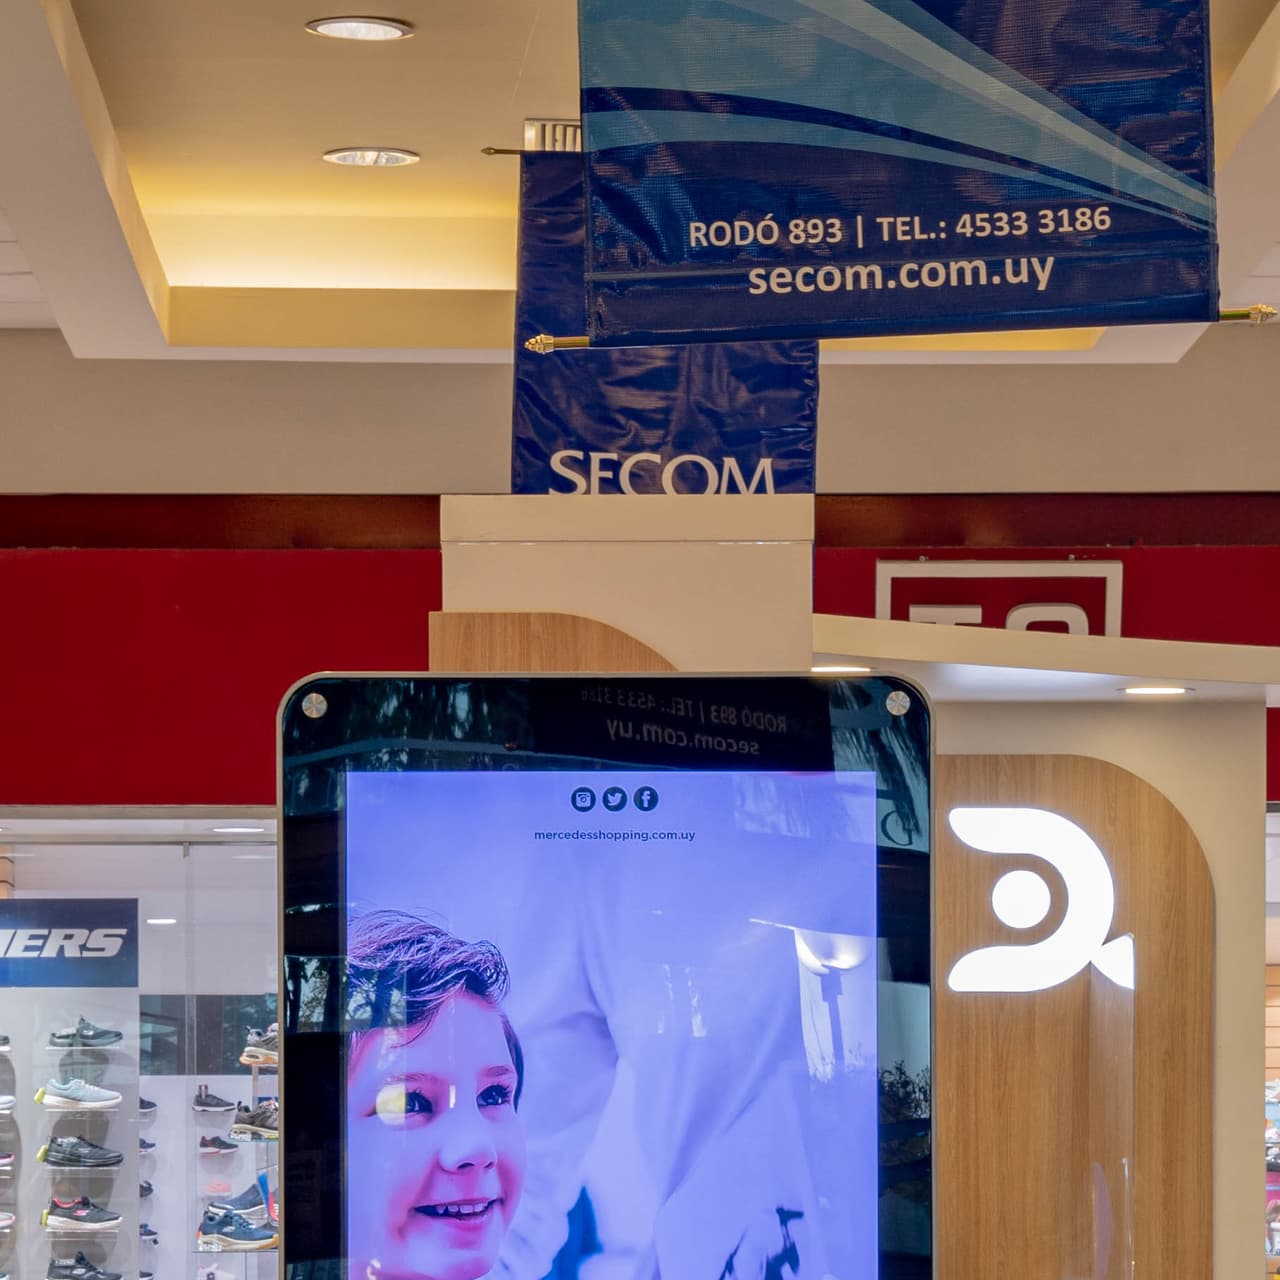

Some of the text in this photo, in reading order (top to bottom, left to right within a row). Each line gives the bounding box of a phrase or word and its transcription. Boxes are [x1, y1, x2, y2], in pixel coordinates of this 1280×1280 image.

[688, 207, 1112, 248] RODÓ 893 TEL.: 4533 3186
[748, 256, 1055, 296] secom.com.uy
[548, 449, 776, 496] SECOM
[533, 829, 696, 842] mercedesshopping.com.uy
